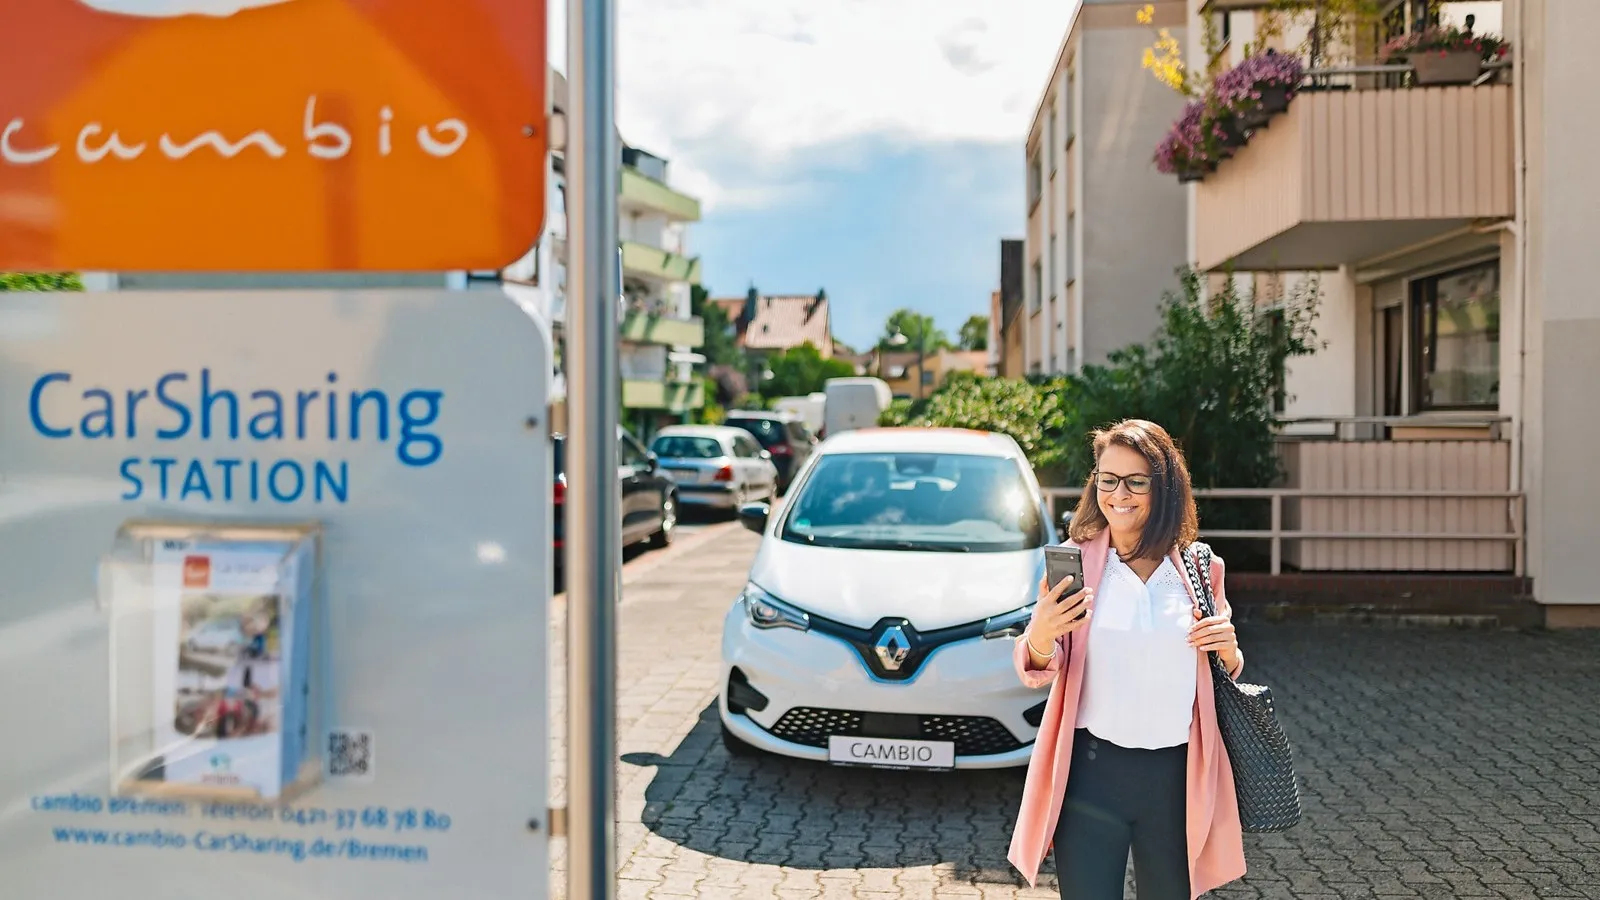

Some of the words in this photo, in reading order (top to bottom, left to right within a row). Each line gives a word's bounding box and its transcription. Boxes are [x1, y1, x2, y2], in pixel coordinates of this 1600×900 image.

[0, 94, 469, 164] cambio
[29, 368, 444, 467] CarSharing
[120, 457, 349, 504] STATION
[850, 742, 933, 762] CAMBIO
[31, 793, 103, 813] cambio
[361, 806, 388, 827] 68
[423, 809, 452, 830] 80
[53, 828, 429, 862] www.cambio-CarSharing.de/Bremen
